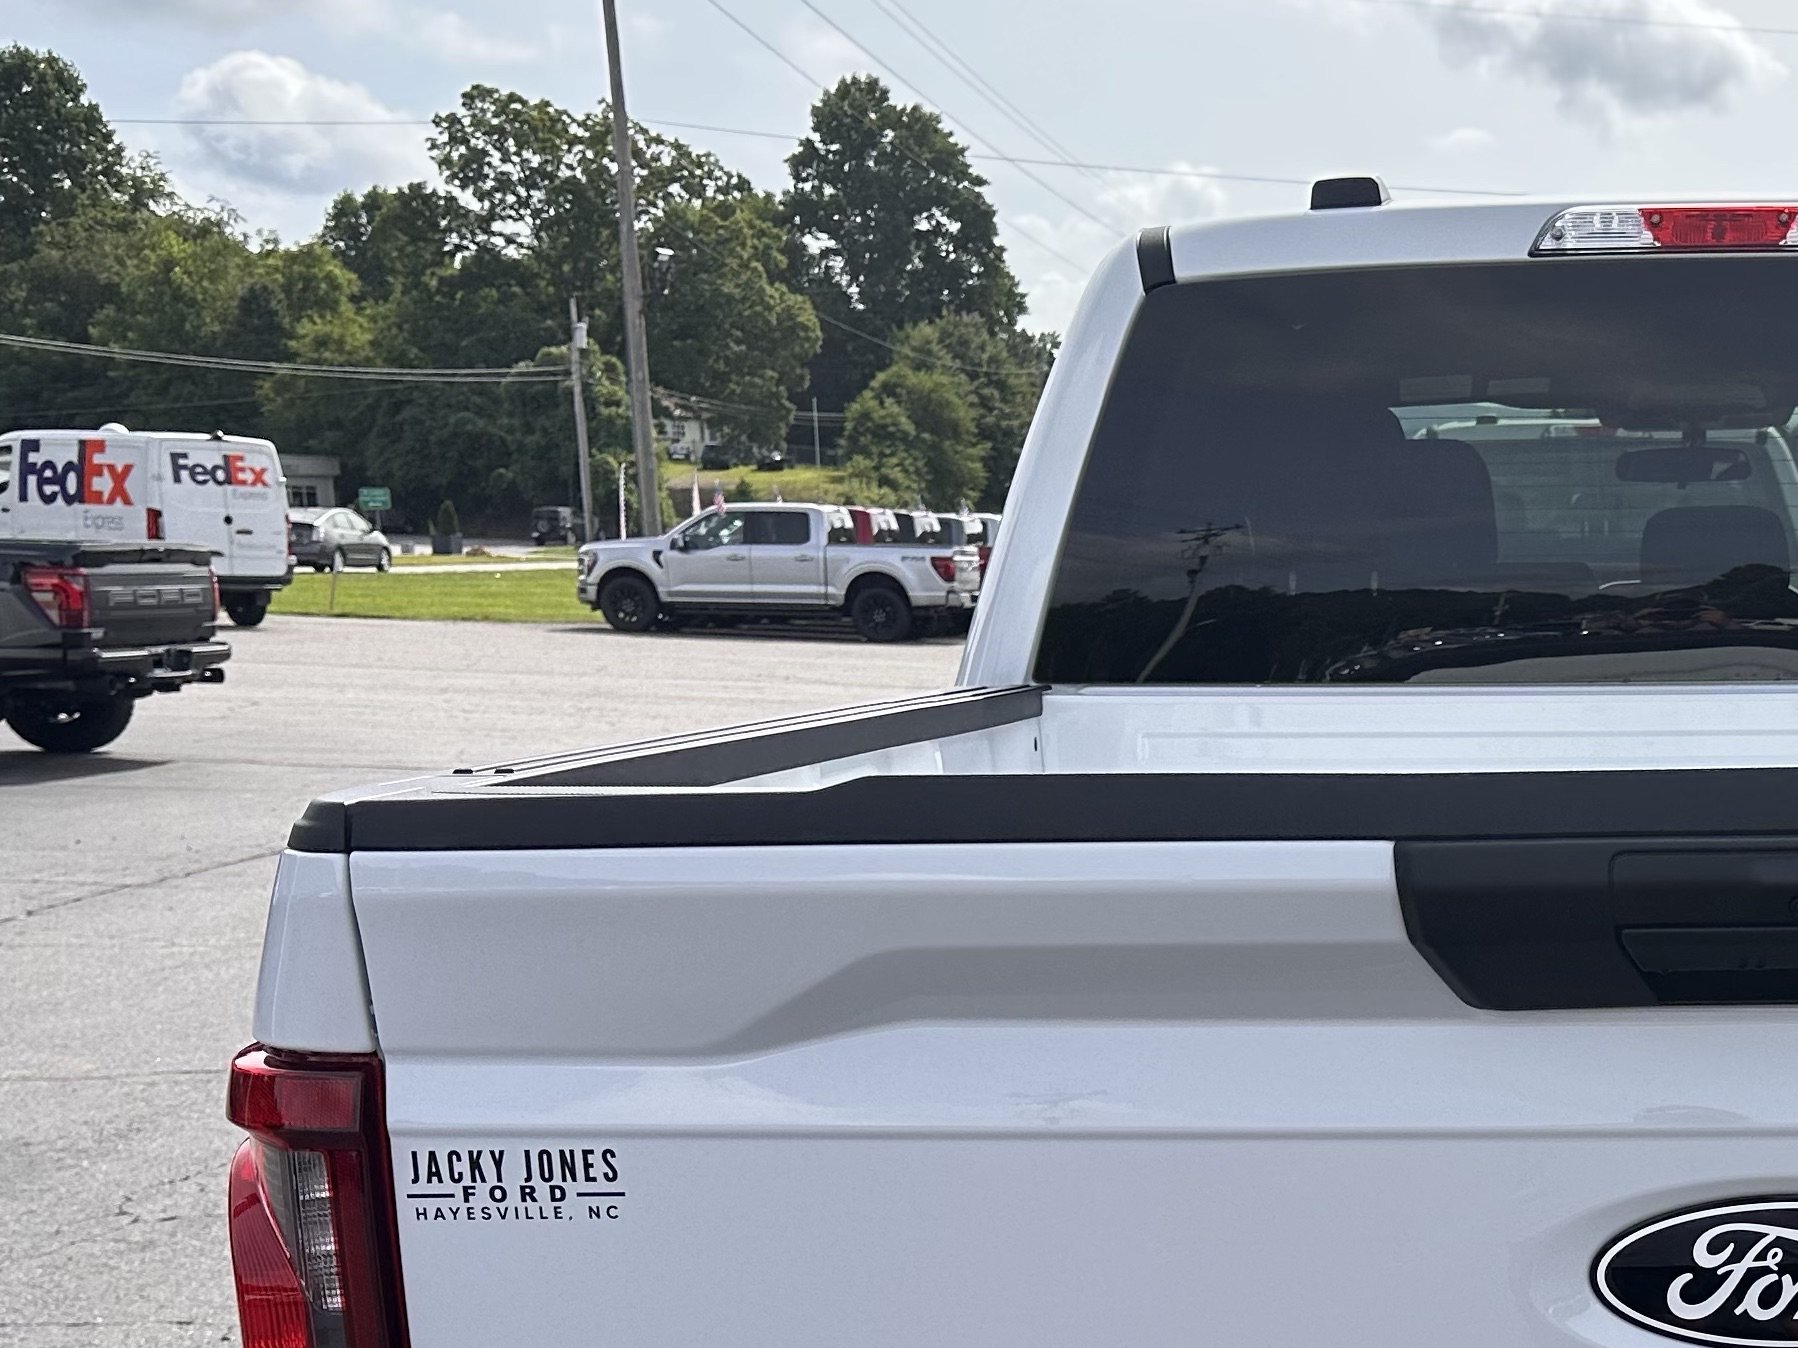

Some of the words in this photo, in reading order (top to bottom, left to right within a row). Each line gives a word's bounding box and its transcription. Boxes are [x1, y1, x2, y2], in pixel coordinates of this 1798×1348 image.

[19, 438, 134, 506] FedEx
[169, 451, 270, 488] FedEx
[108, 588, 203, 606] FORD
[410, 1149, 505, 1184] JACKY
[523, 1148, 619, 1184] JONES
[462, 1184, 567, 1203] FORD
[415, 1206, 573, 1221] HAYESVILLE,
[588, 1205, 619, 1220] NC
